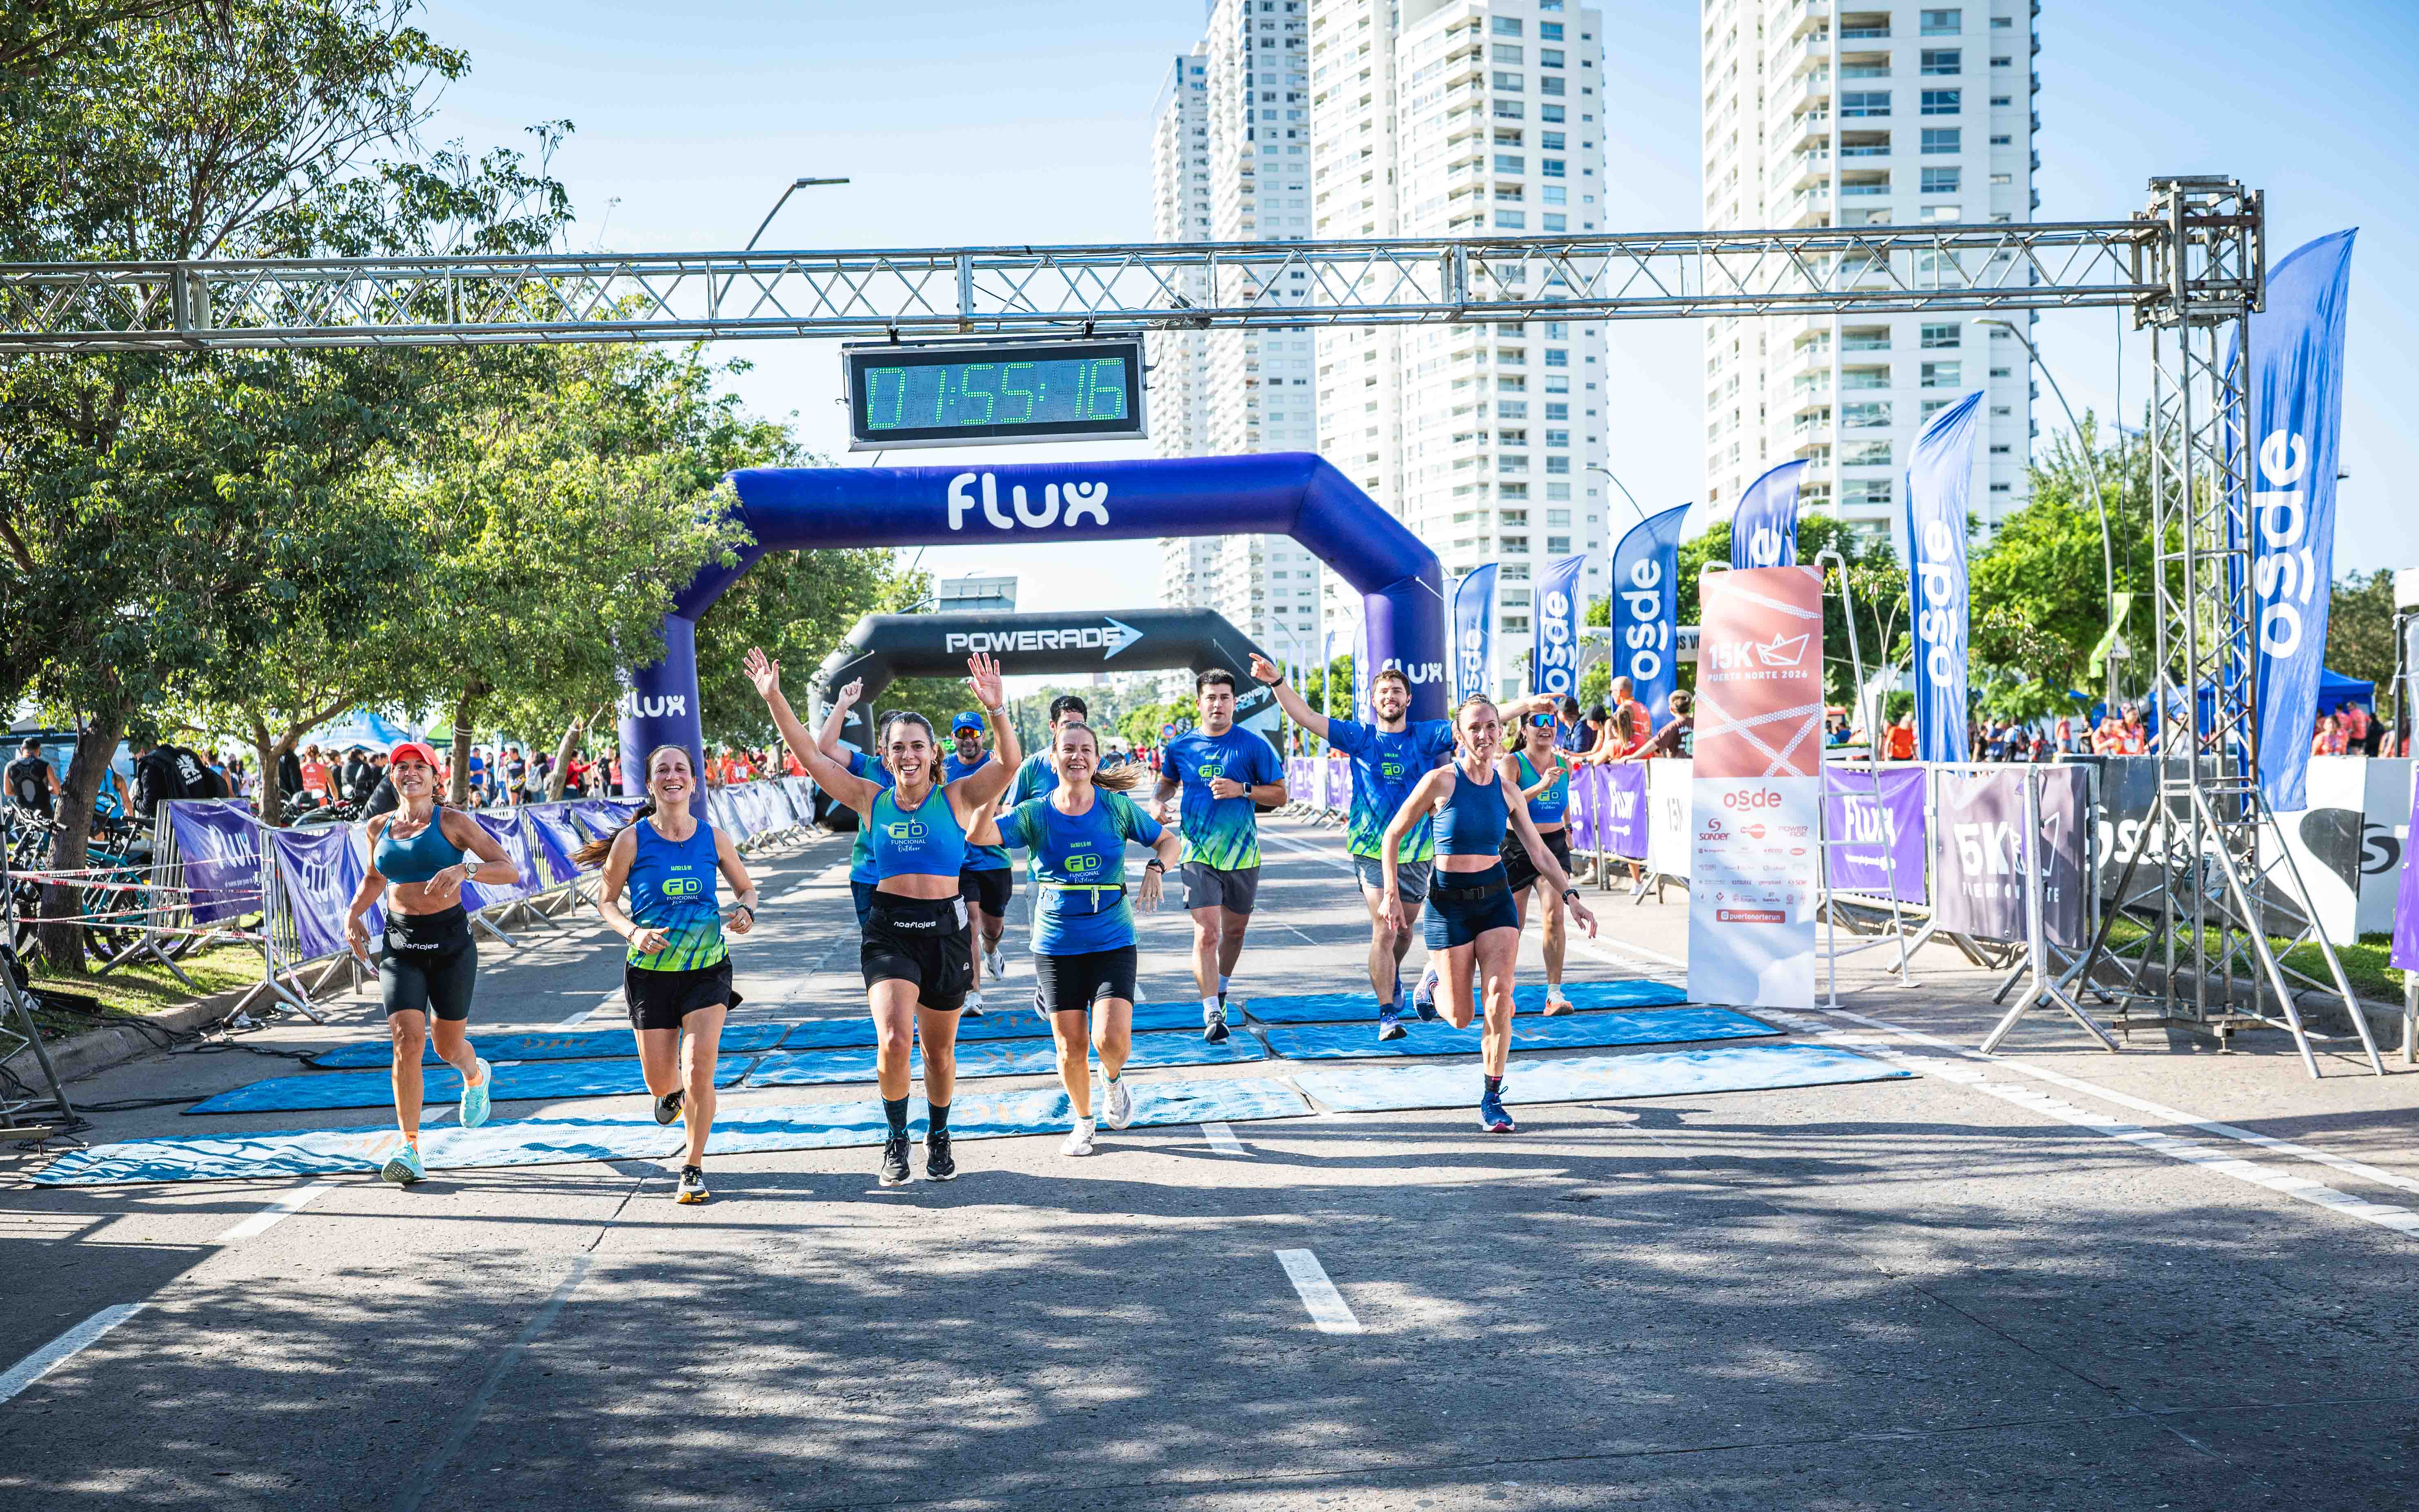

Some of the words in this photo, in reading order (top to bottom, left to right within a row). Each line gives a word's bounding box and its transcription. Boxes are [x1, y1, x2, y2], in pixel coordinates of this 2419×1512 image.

[867, 357, 1123, 429] 01:55:16
[948, 472, 1110, 530] flux
[2250, 429, 2314, 658] osde
[1620, 558, 1668, 680] osde
[1917, 520, 1957, 687] osde
[946, 627, 1122, 653] POWERADE
[1460, 628, 1488, 696] sde
[1540, 590, 1576, 695] osde
[1708, 641, 1754, 670] 15K
[1745, 671, 1777, 679] NORTE
[1781, 670, 1808, 679] 2026
[617, 691, 686, 718] lux
[1724, 787, 1781, 811] osde
[1952, 821, 2009, 876] 5K
[398, 940, 439, 950] noaflojes
[894, 921, 936, 929] noaflojes
